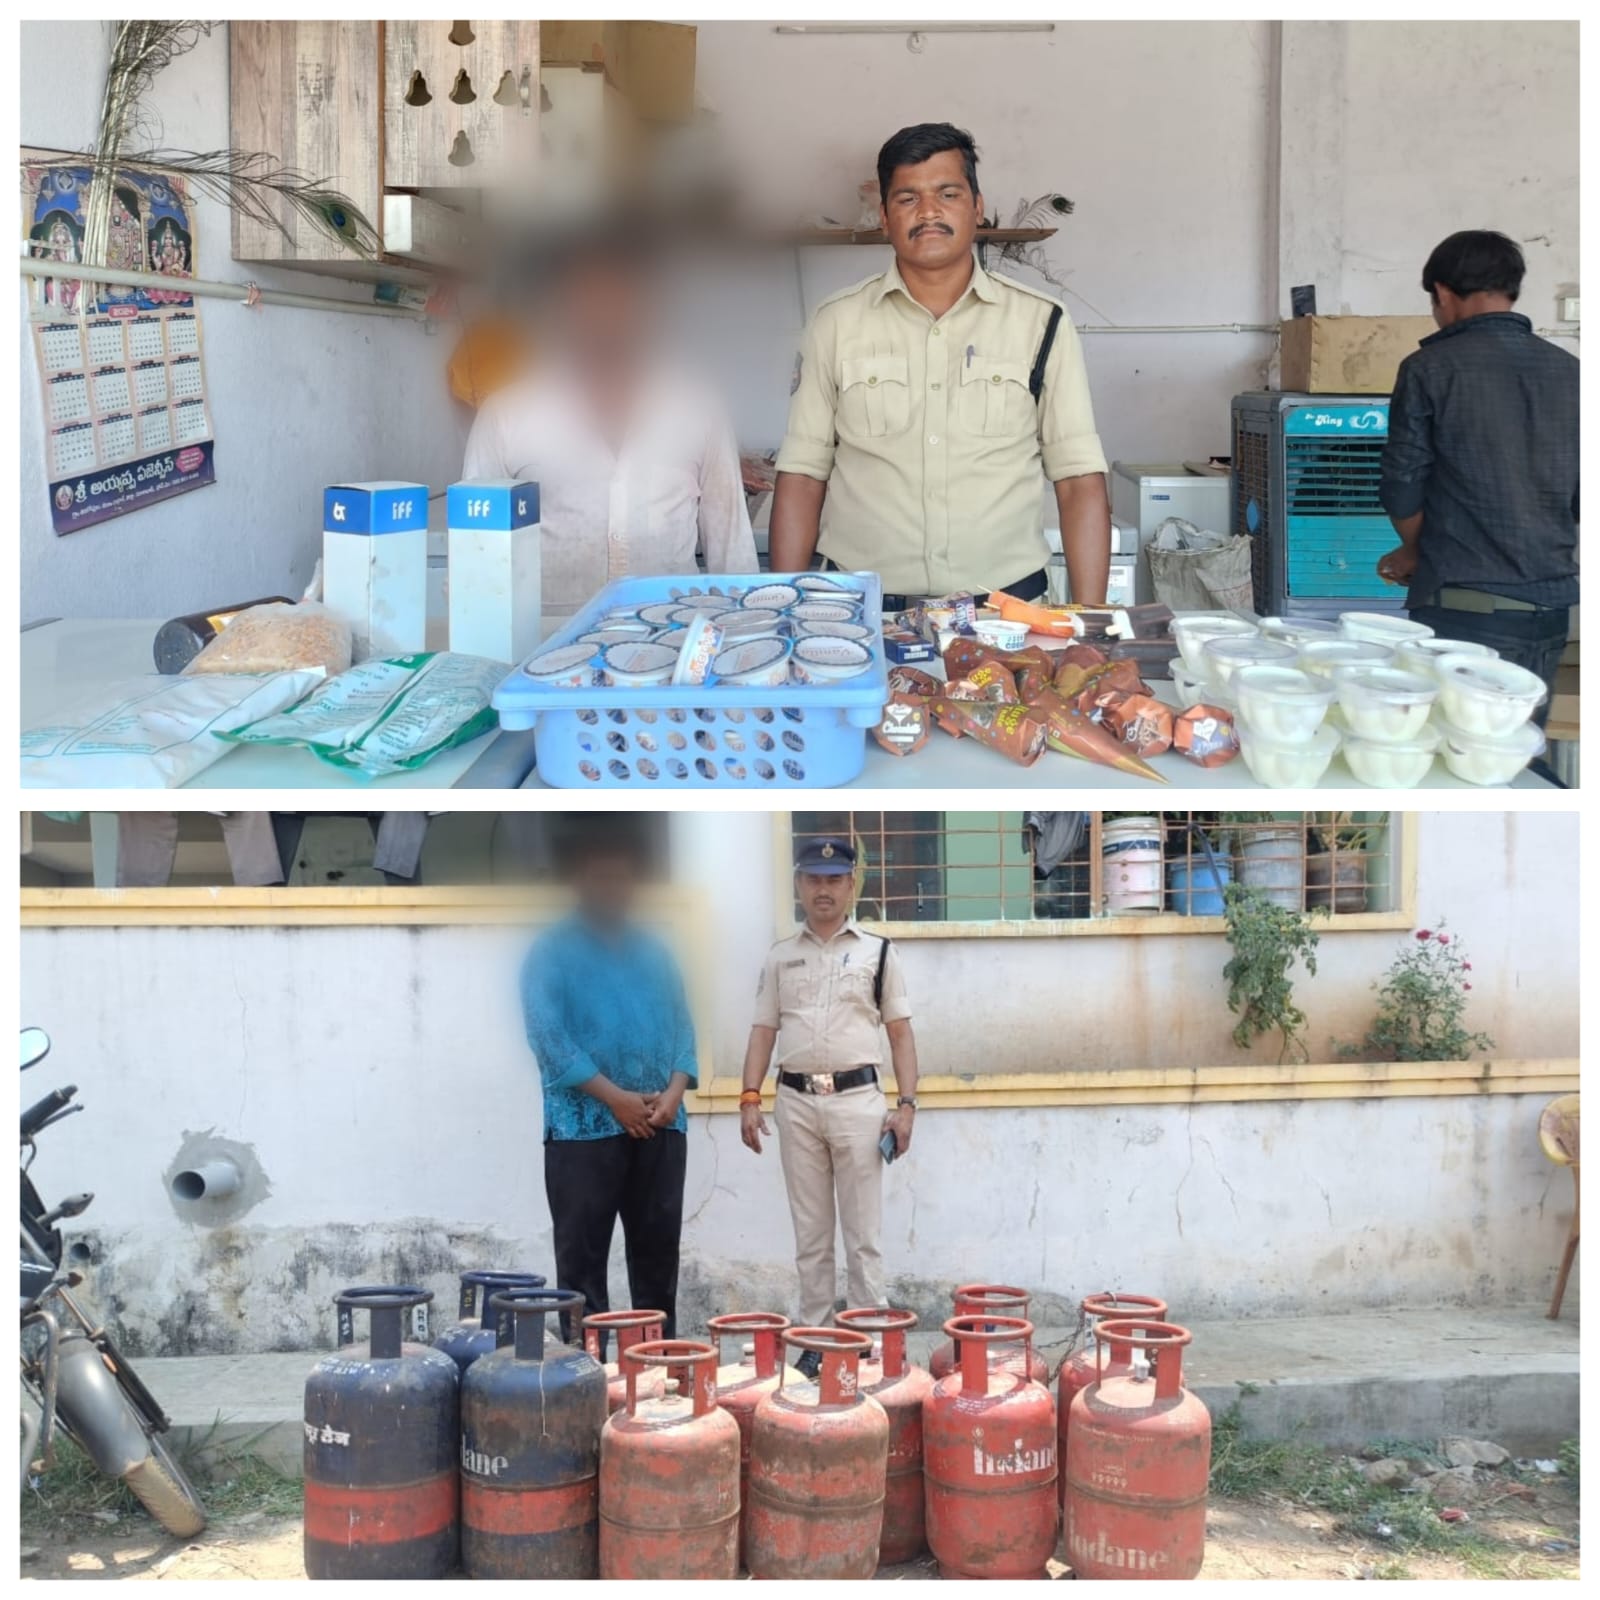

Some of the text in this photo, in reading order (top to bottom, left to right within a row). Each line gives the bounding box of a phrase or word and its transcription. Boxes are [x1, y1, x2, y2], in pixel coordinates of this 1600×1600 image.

[75, 480, 88, 503] శ్రీ
[392, 500, 413, 520] iff
[467, 499, 491, 518] iff
